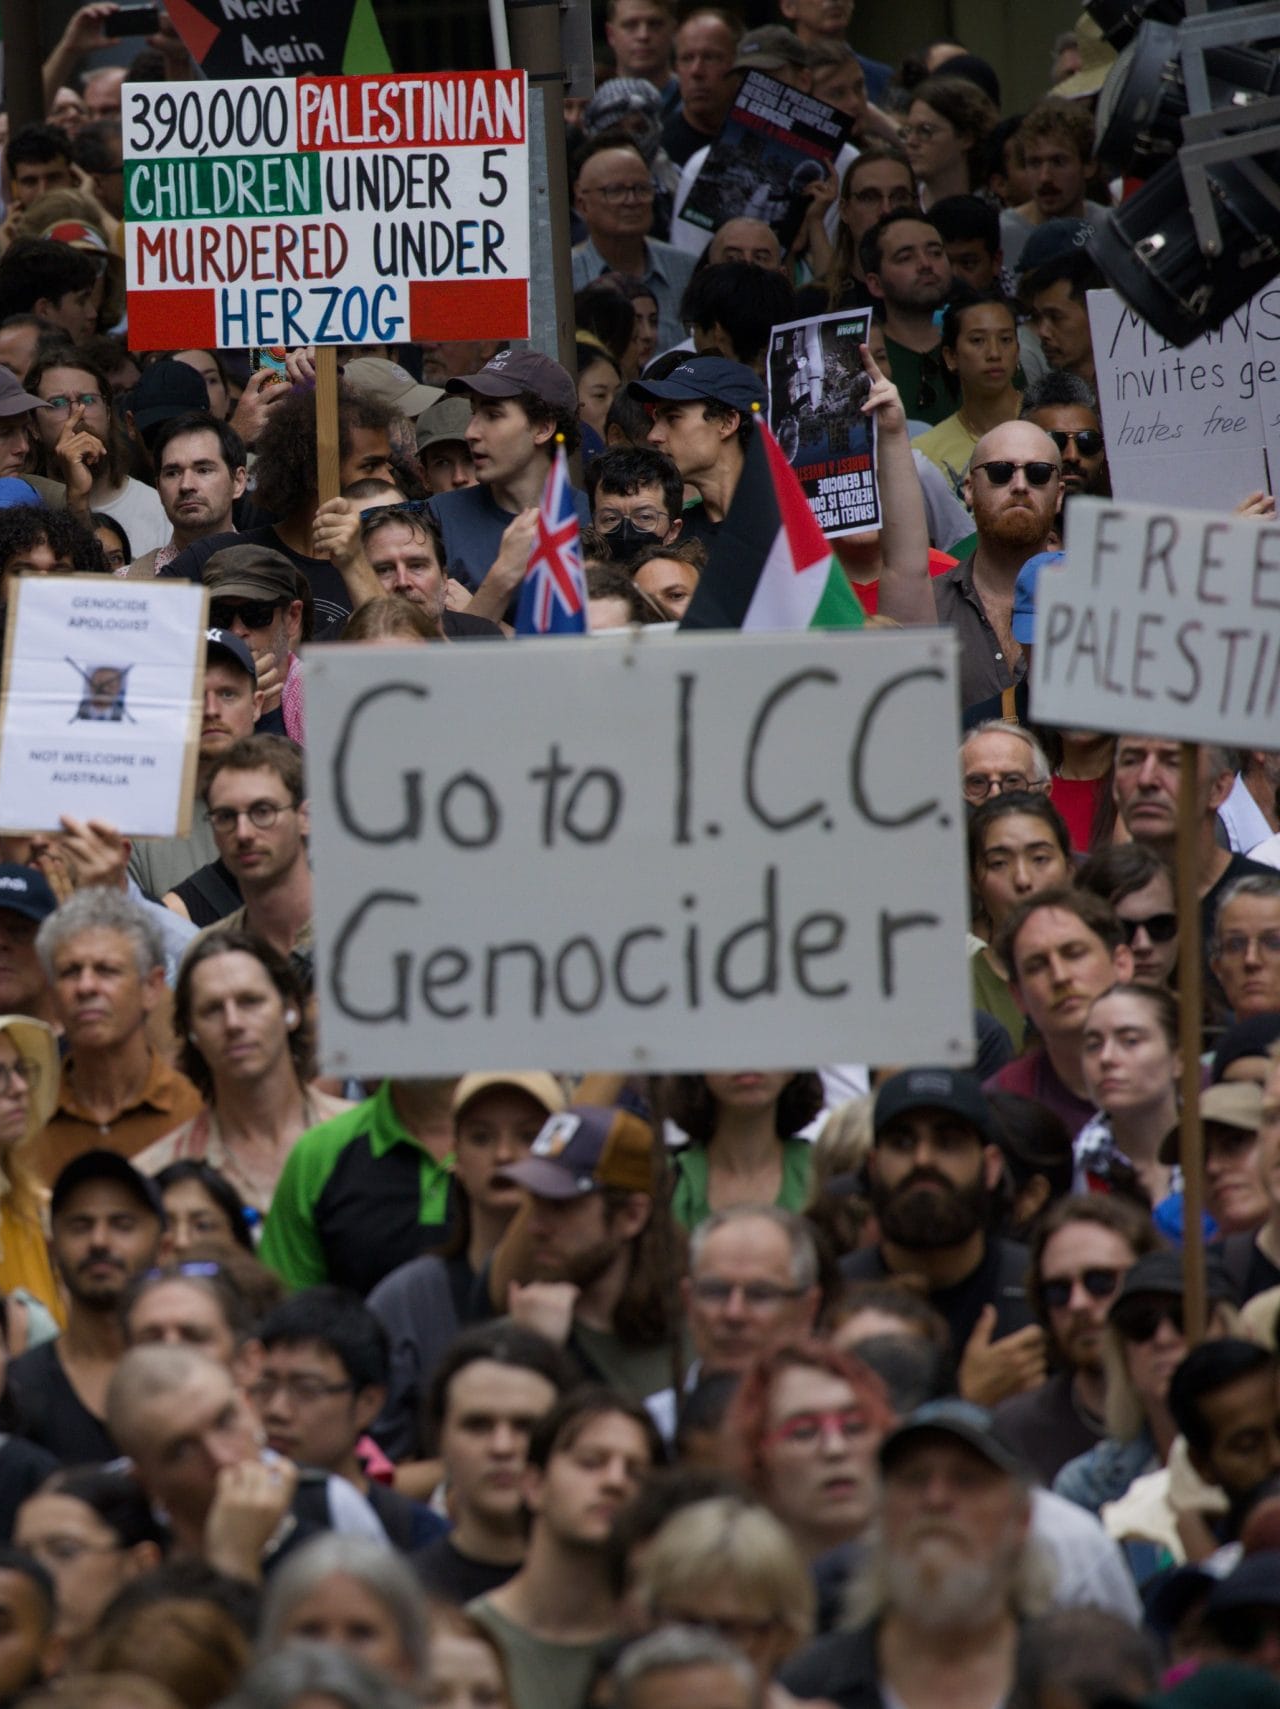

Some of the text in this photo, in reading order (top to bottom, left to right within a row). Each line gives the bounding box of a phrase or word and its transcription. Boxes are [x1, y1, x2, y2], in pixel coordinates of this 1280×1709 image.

[220, 0, 301, 21] Never
[241, 33, 325, 77] Again
[130, 77, 521, 157] 390,000 PALESTINIAN
[129, 148, 508, 218] CHILDREN UNDER 5
[137, 219, 508, 285] MURDERED UNDER
[221, 284, 405, 346] HERZOG
[1115, 358, 1225, 400] invites
[1117, 411, 1184, 446] hates
[1203, 405, 1248, 437] free
[817, 473, 860, 493] GENOCIDE
[828, 491, 838, 509] IS
[839, 487, 874, 507] HERZOG
[842, 503, 875, 524] ISRAELI
[1092, 510, 1280, 613] FREE
[68, 617, 150, 631] APOLOGIST
[73, 596, 149, 611] GENOCIDE
[29, 750, 156, 767] NOT WELCOME IN
[51, 771, 130, 787] AUSTRALIA
[332, 667, 953, 850] Go to I.C.C.
[331, 865, 941, 1024] Genocider
